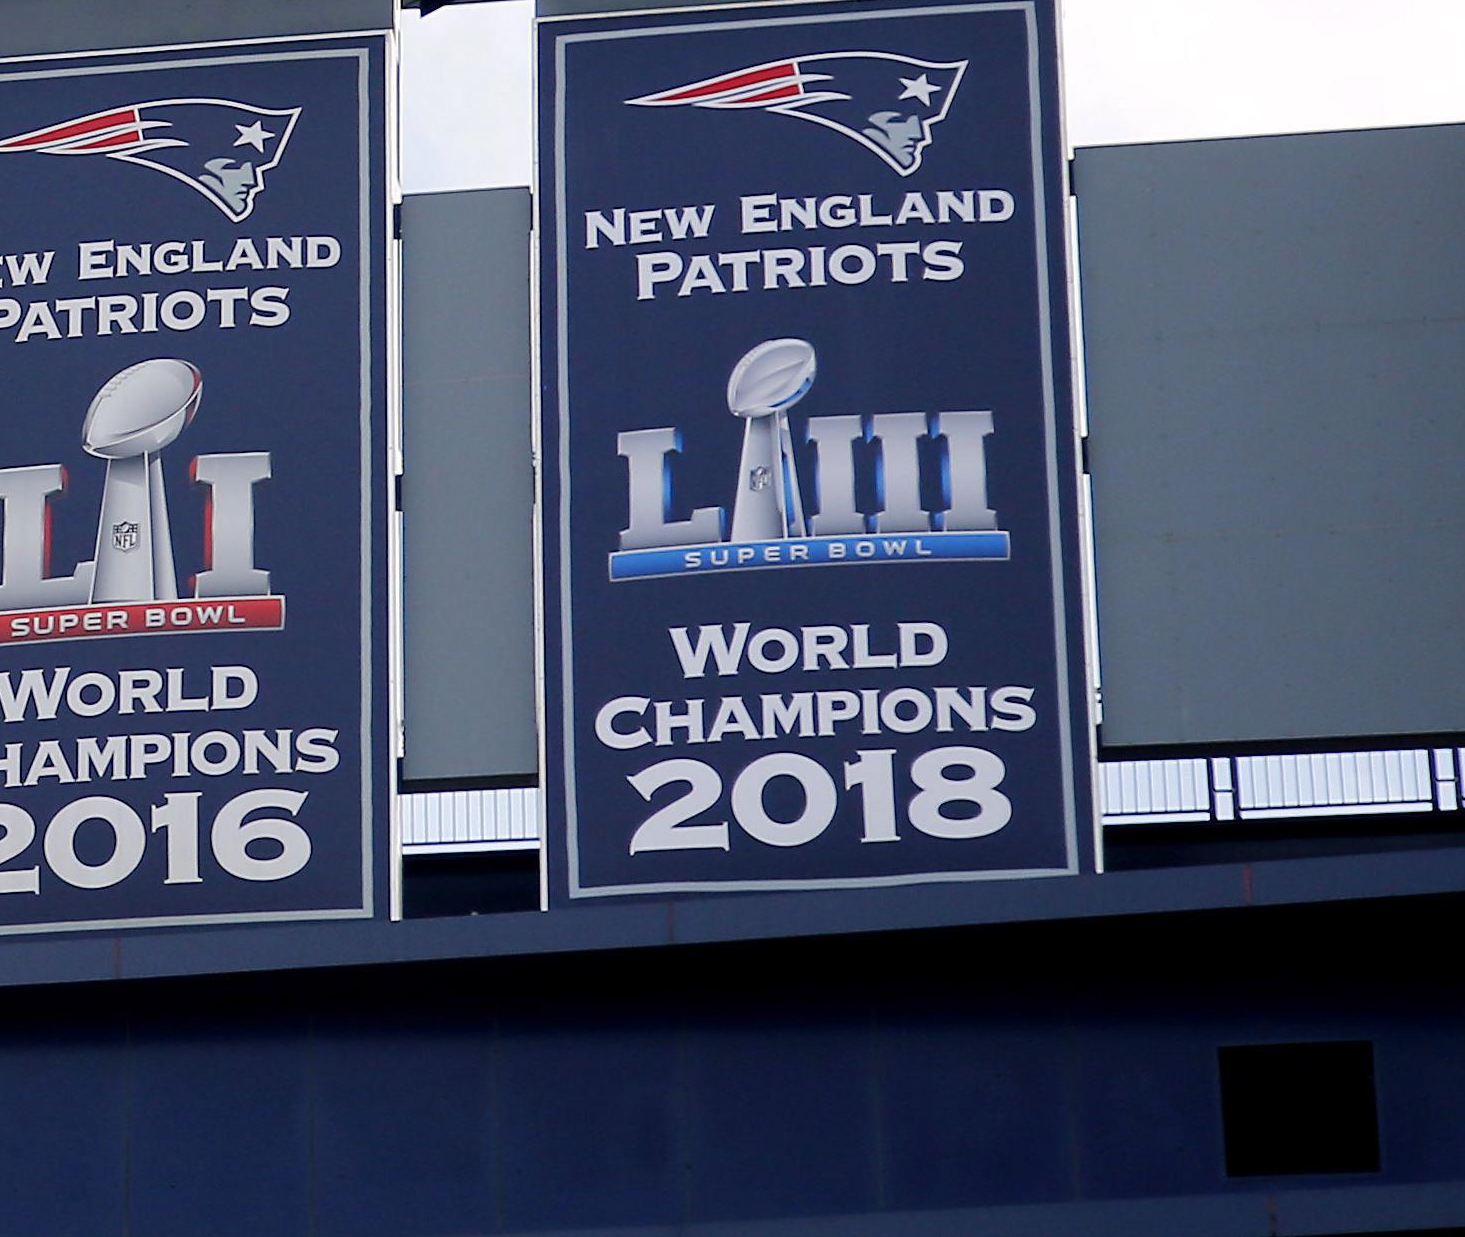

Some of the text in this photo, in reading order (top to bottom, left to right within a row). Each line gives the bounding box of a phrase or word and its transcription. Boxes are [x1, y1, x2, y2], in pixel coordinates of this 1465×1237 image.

[584, 189, 1015, 249] NEW ENGLAND
[77, 236, 341, 280] ENGLAND
[635, 240, 964, 301] PATRIOTS
[684, 540, 932, 568] SUPER BOWL
[10, 605, 246, 637] SUPER BOWL
[668, 622, 948, 679] WORLD
[594, 686, 1036, 749] CHAMPIONS
[626, 746, 1012, 856] 2018
